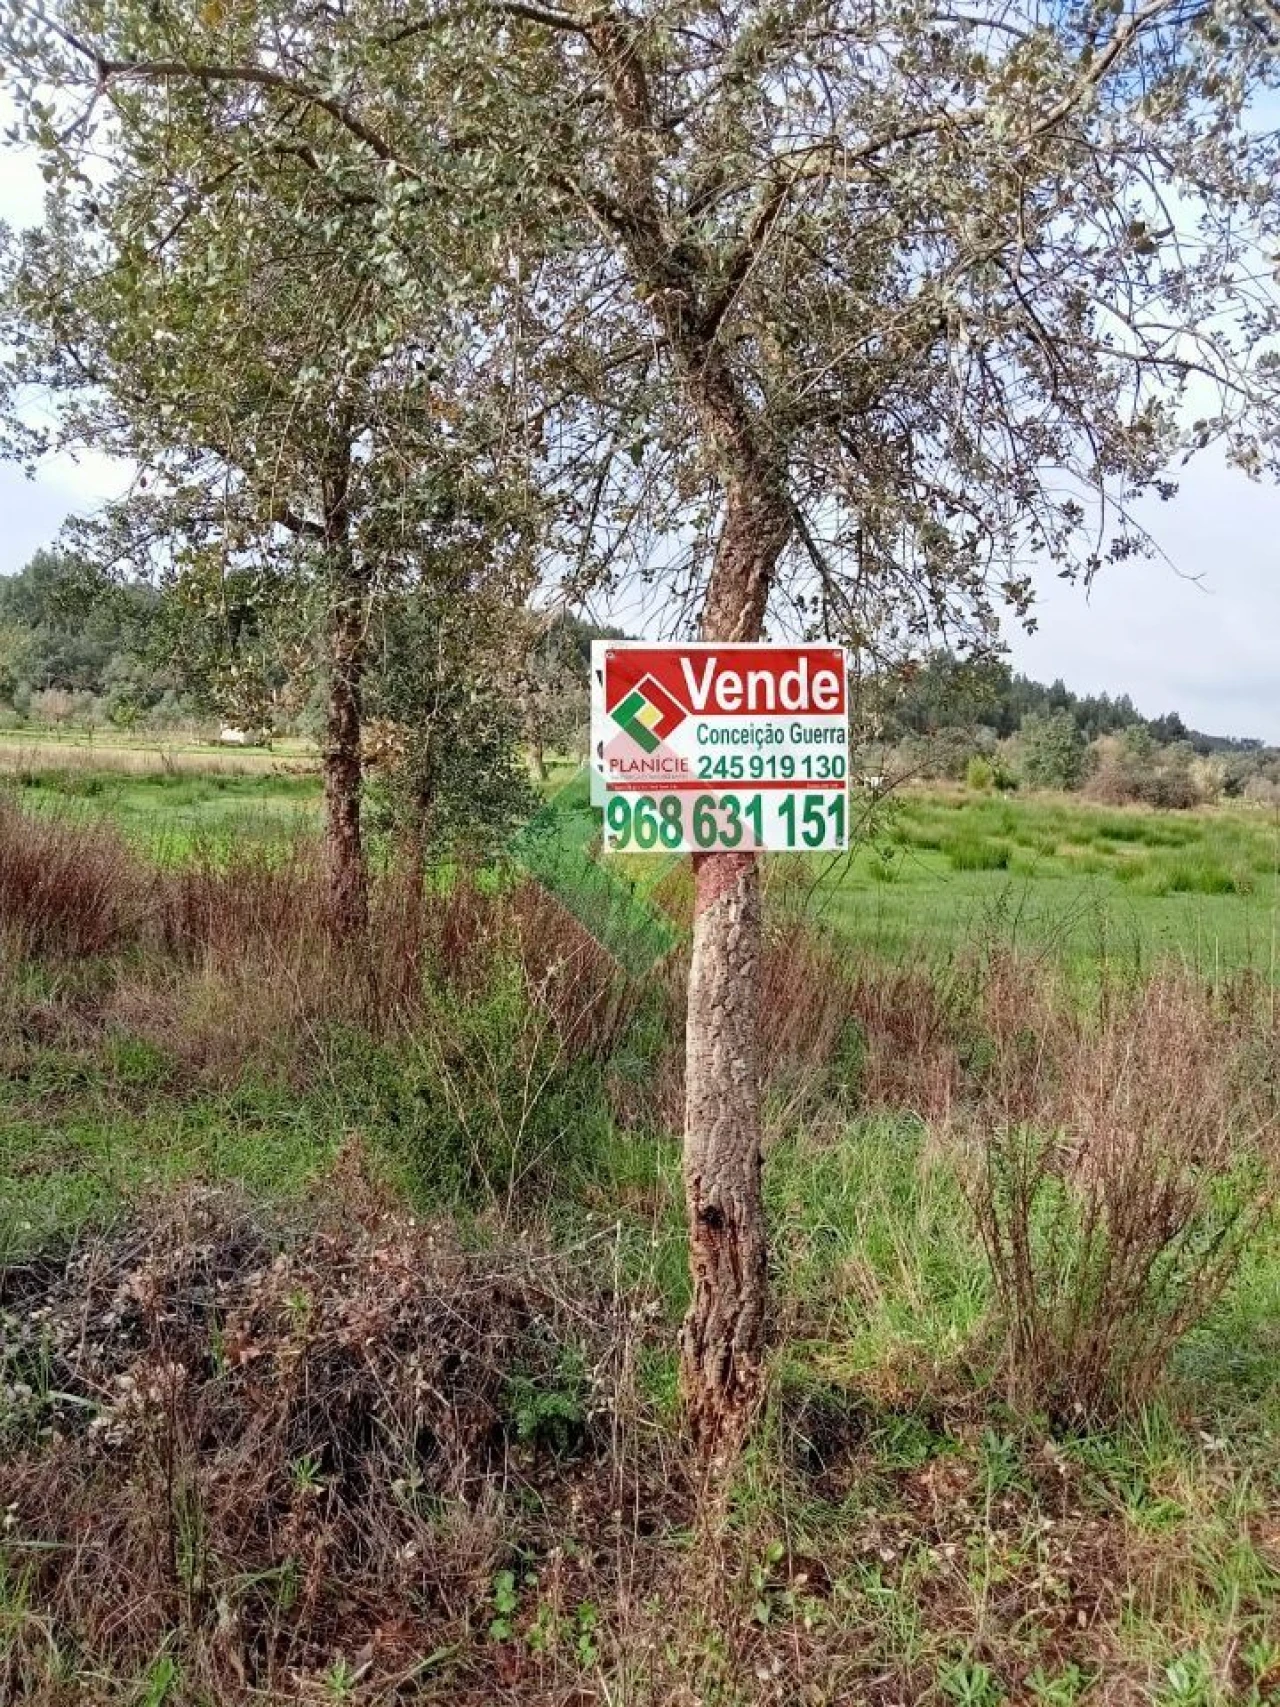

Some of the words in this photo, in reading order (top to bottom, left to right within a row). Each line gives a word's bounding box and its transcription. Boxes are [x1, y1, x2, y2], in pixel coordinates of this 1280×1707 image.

[680, 657, 840, 711] Vende
[697, 723, 784, 749] Conceição
[790, 724, 845, 744] Guerra
[698, 756, 744, 779] 245
[749, 756, 795, 779] 919
[801, 755, 845, 779] 130
[607, 795, 683, 849] 968
[692, 794, 763, 849] 631
[778, 794, 845, 847] 151
